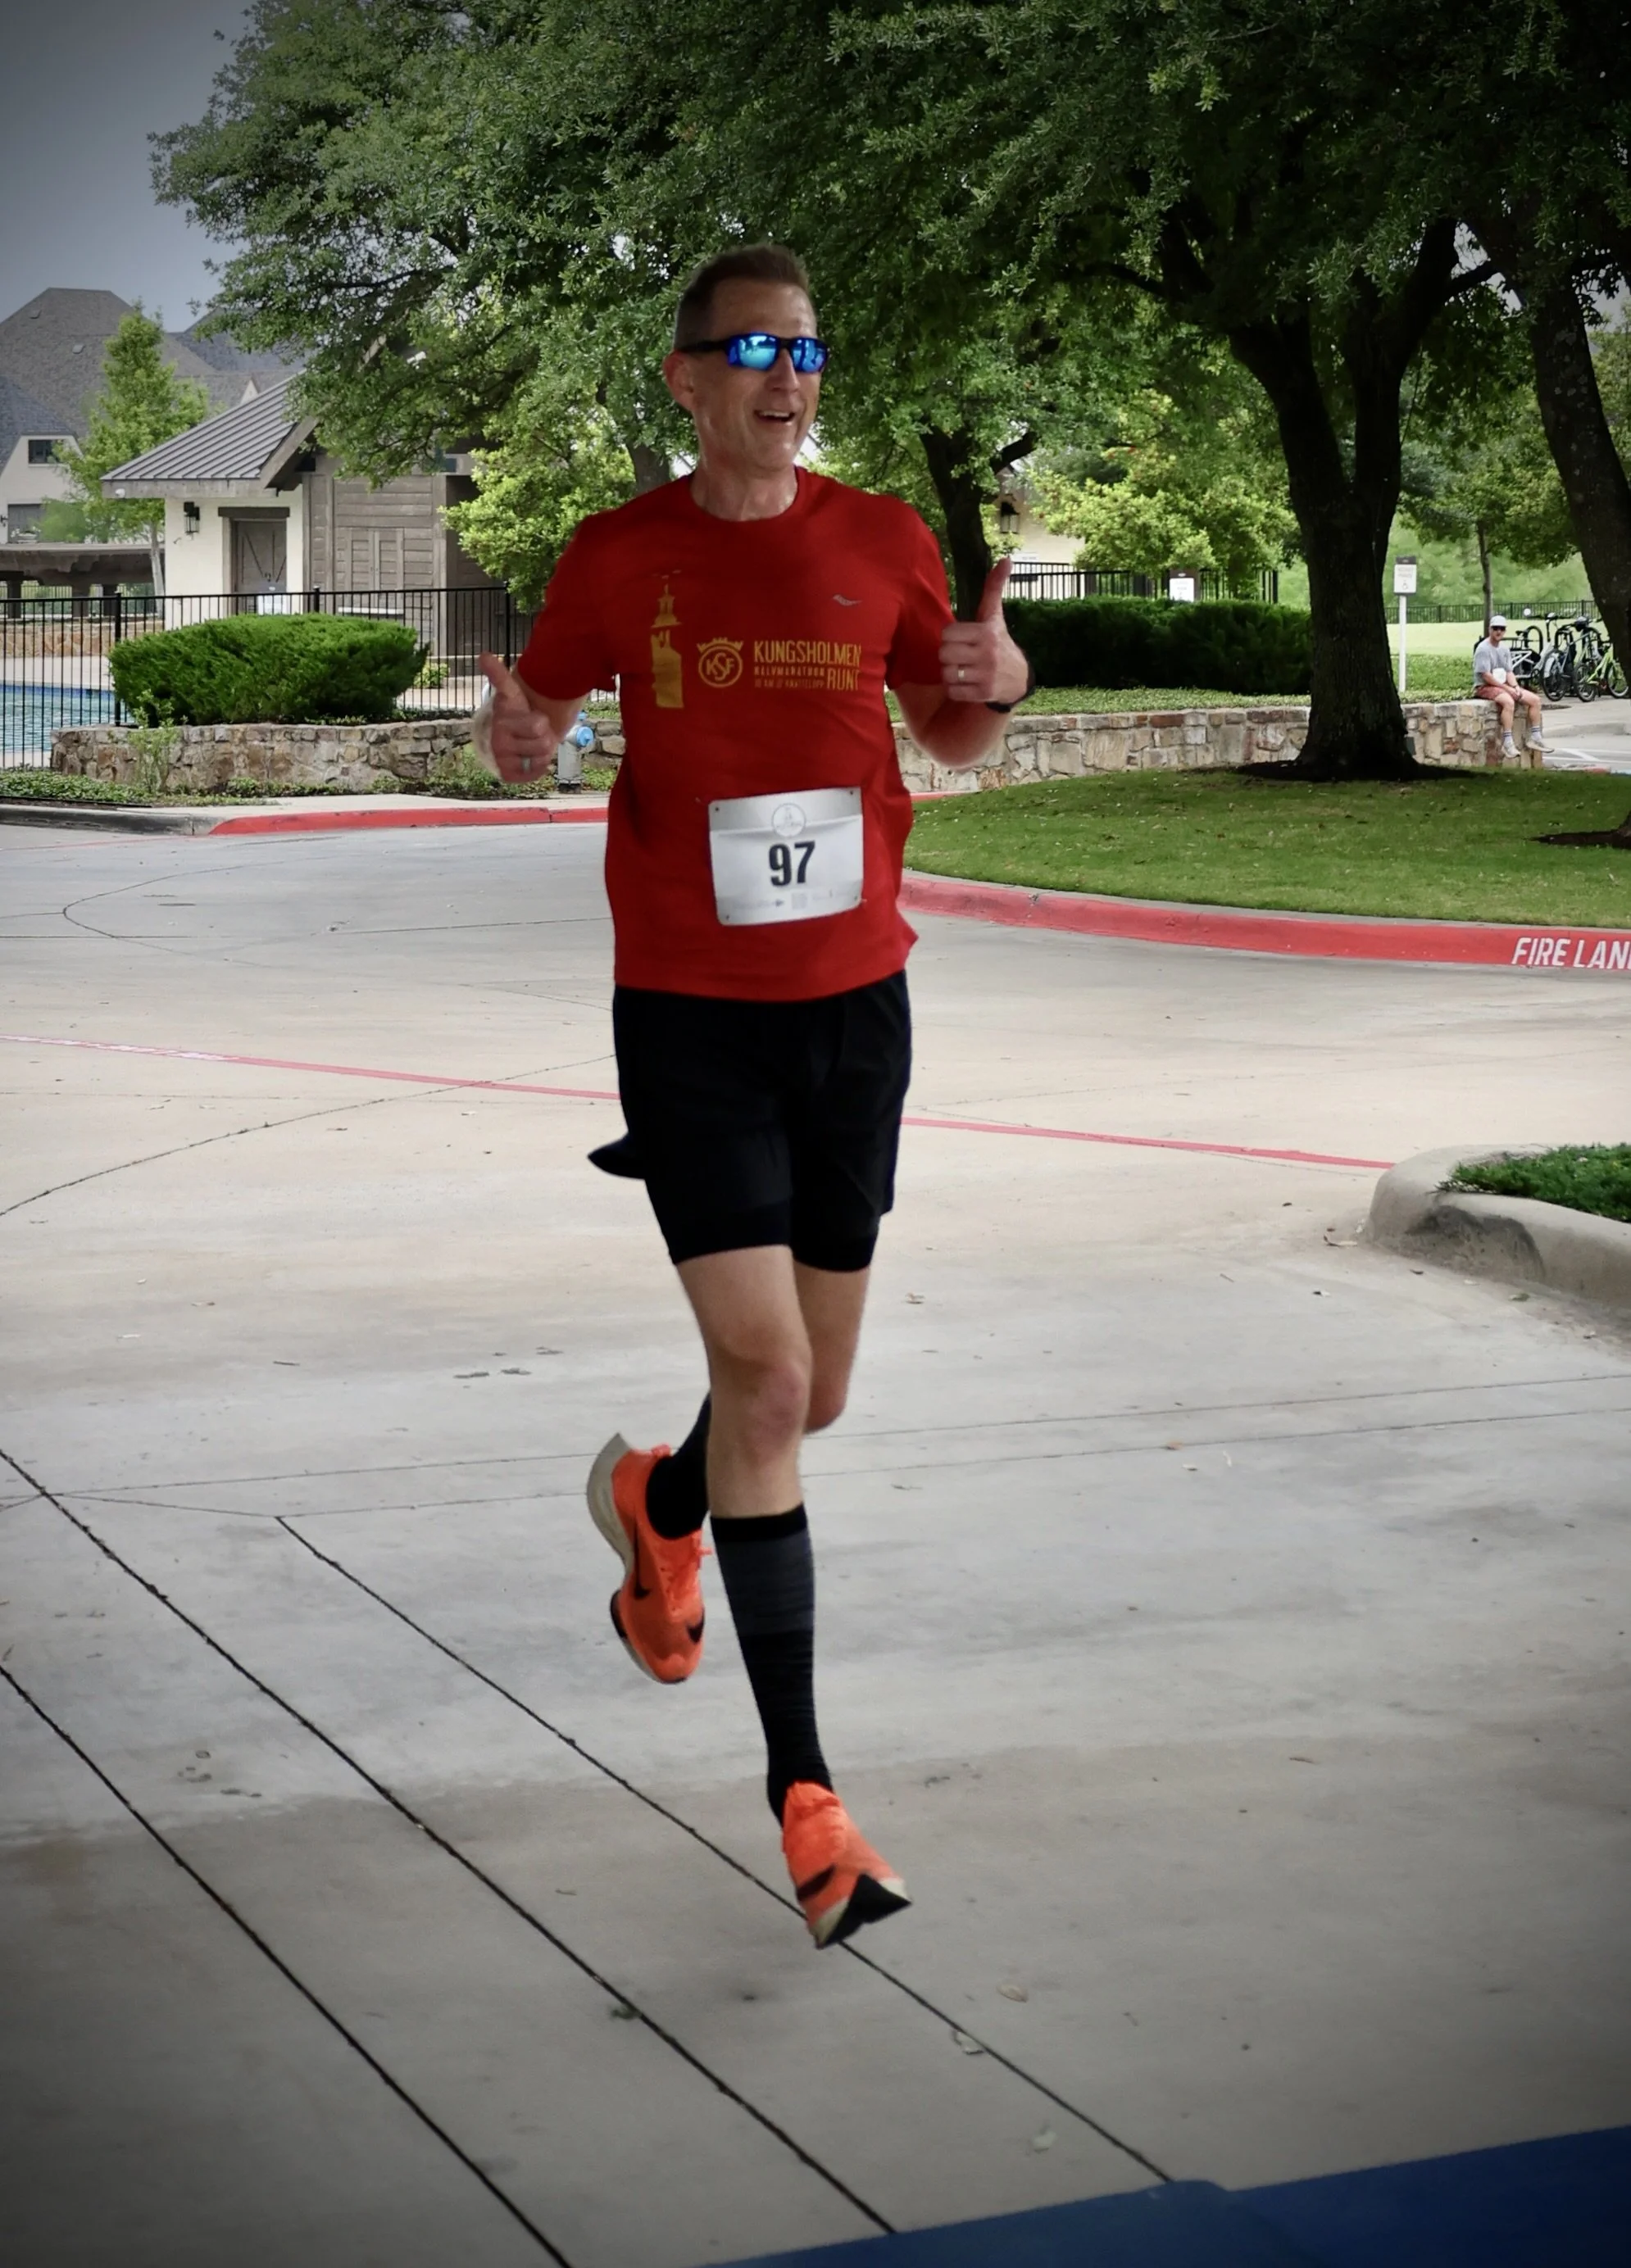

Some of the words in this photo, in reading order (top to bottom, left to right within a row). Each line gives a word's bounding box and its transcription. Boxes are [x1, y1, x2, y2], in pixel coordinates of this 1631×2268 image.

[754, 640, 861, 667] KUNGSHOLMEN
[769, 840, 816, 887] 97
[1511, 937, 1571, 966] FIRE
[1573, 939, 1631, 970] LAN
